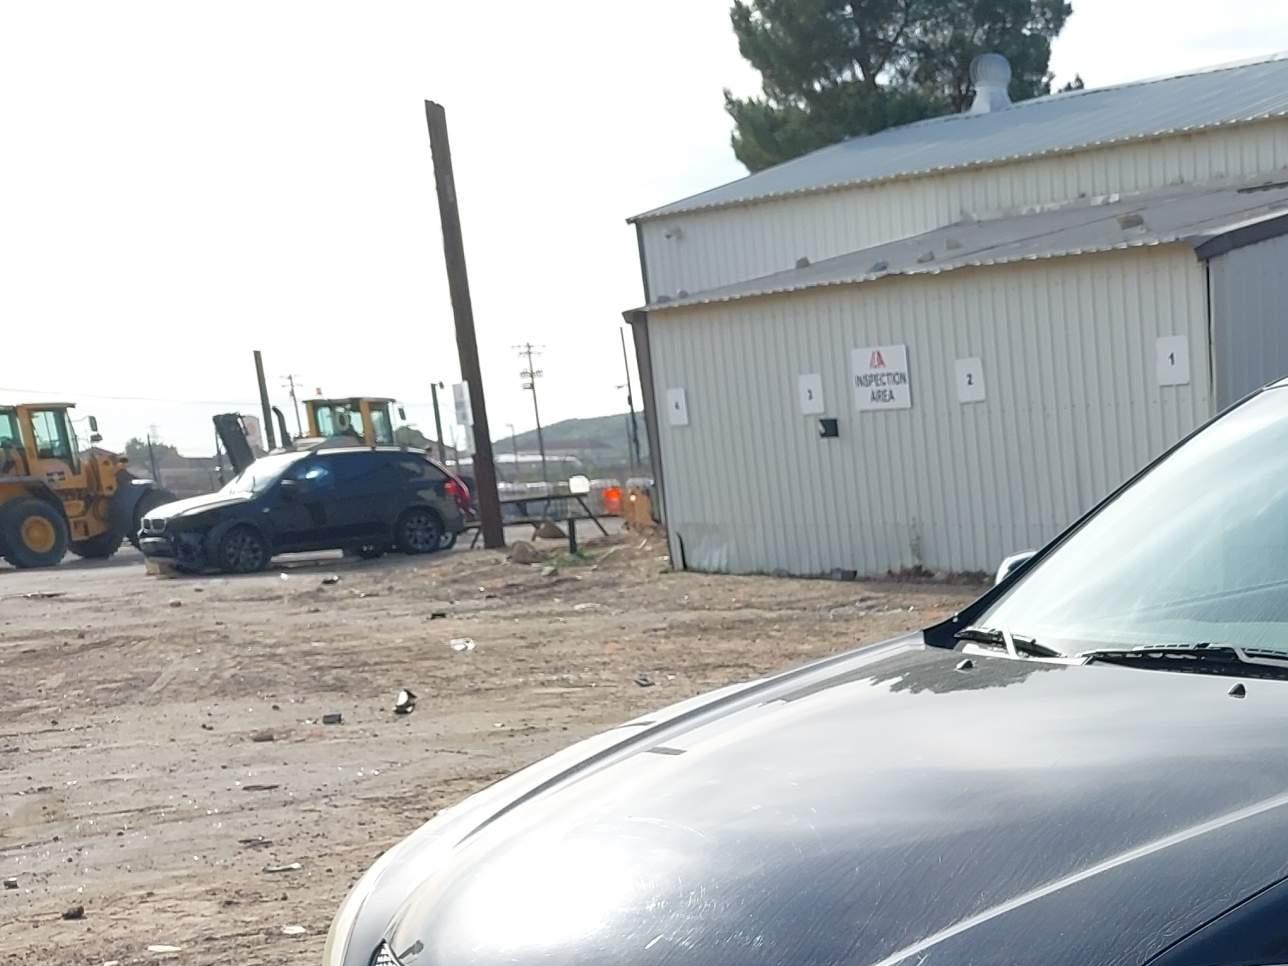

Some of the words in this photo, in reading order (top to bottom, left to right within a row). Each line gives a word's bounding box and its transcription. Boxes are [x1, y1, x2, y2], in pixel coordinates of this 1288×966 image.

[1168, 352, 1176, 366] 1
[855, 372, 907, 388] INSPECTION
[966, 373, 974, 386] 2
[871, 389, 895, 403] AREA
